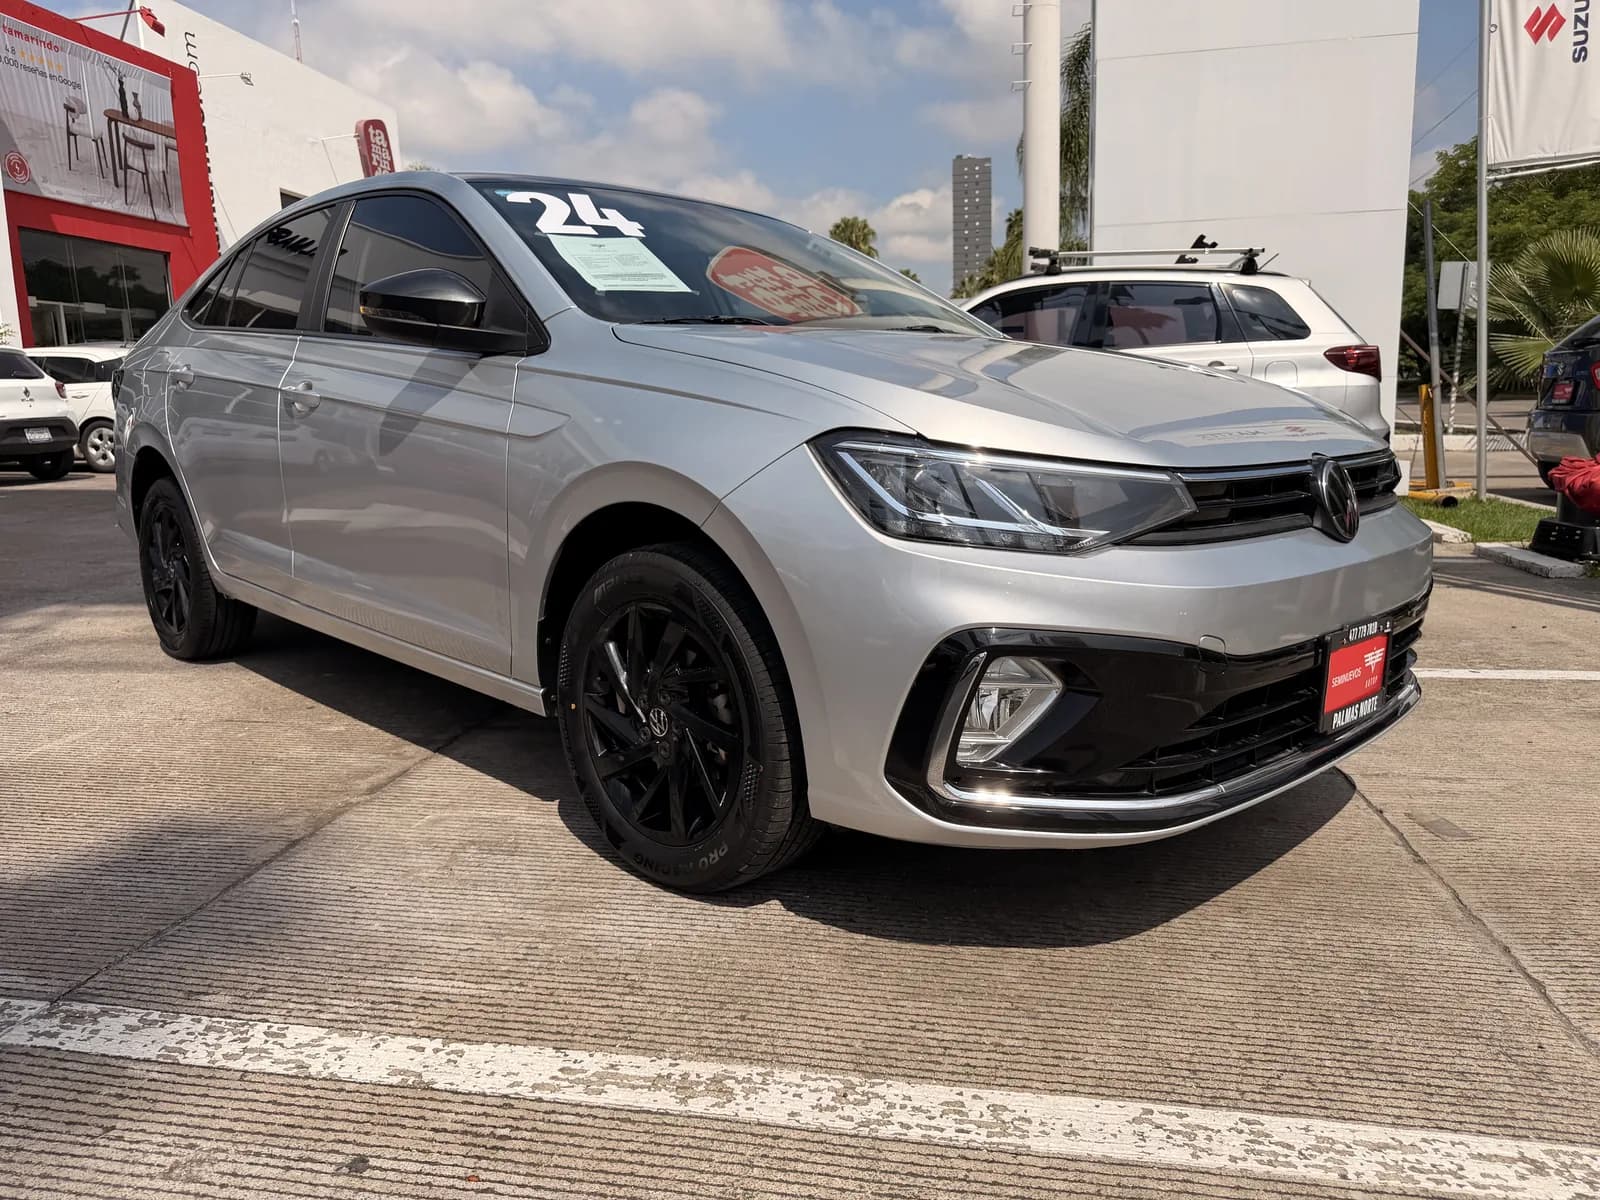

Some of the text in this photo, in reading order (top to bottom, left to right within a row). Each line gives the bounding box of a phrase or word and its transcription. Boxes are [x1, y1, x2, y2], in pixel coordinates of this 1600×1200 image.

[2, 23, 60, 53] tamarindo
[506, 191, 646, 237] 24
[1331, 667, 1362, 688] SEMINUEVOS
[1332, 696, 1378, 729] PALMAS NORTE
